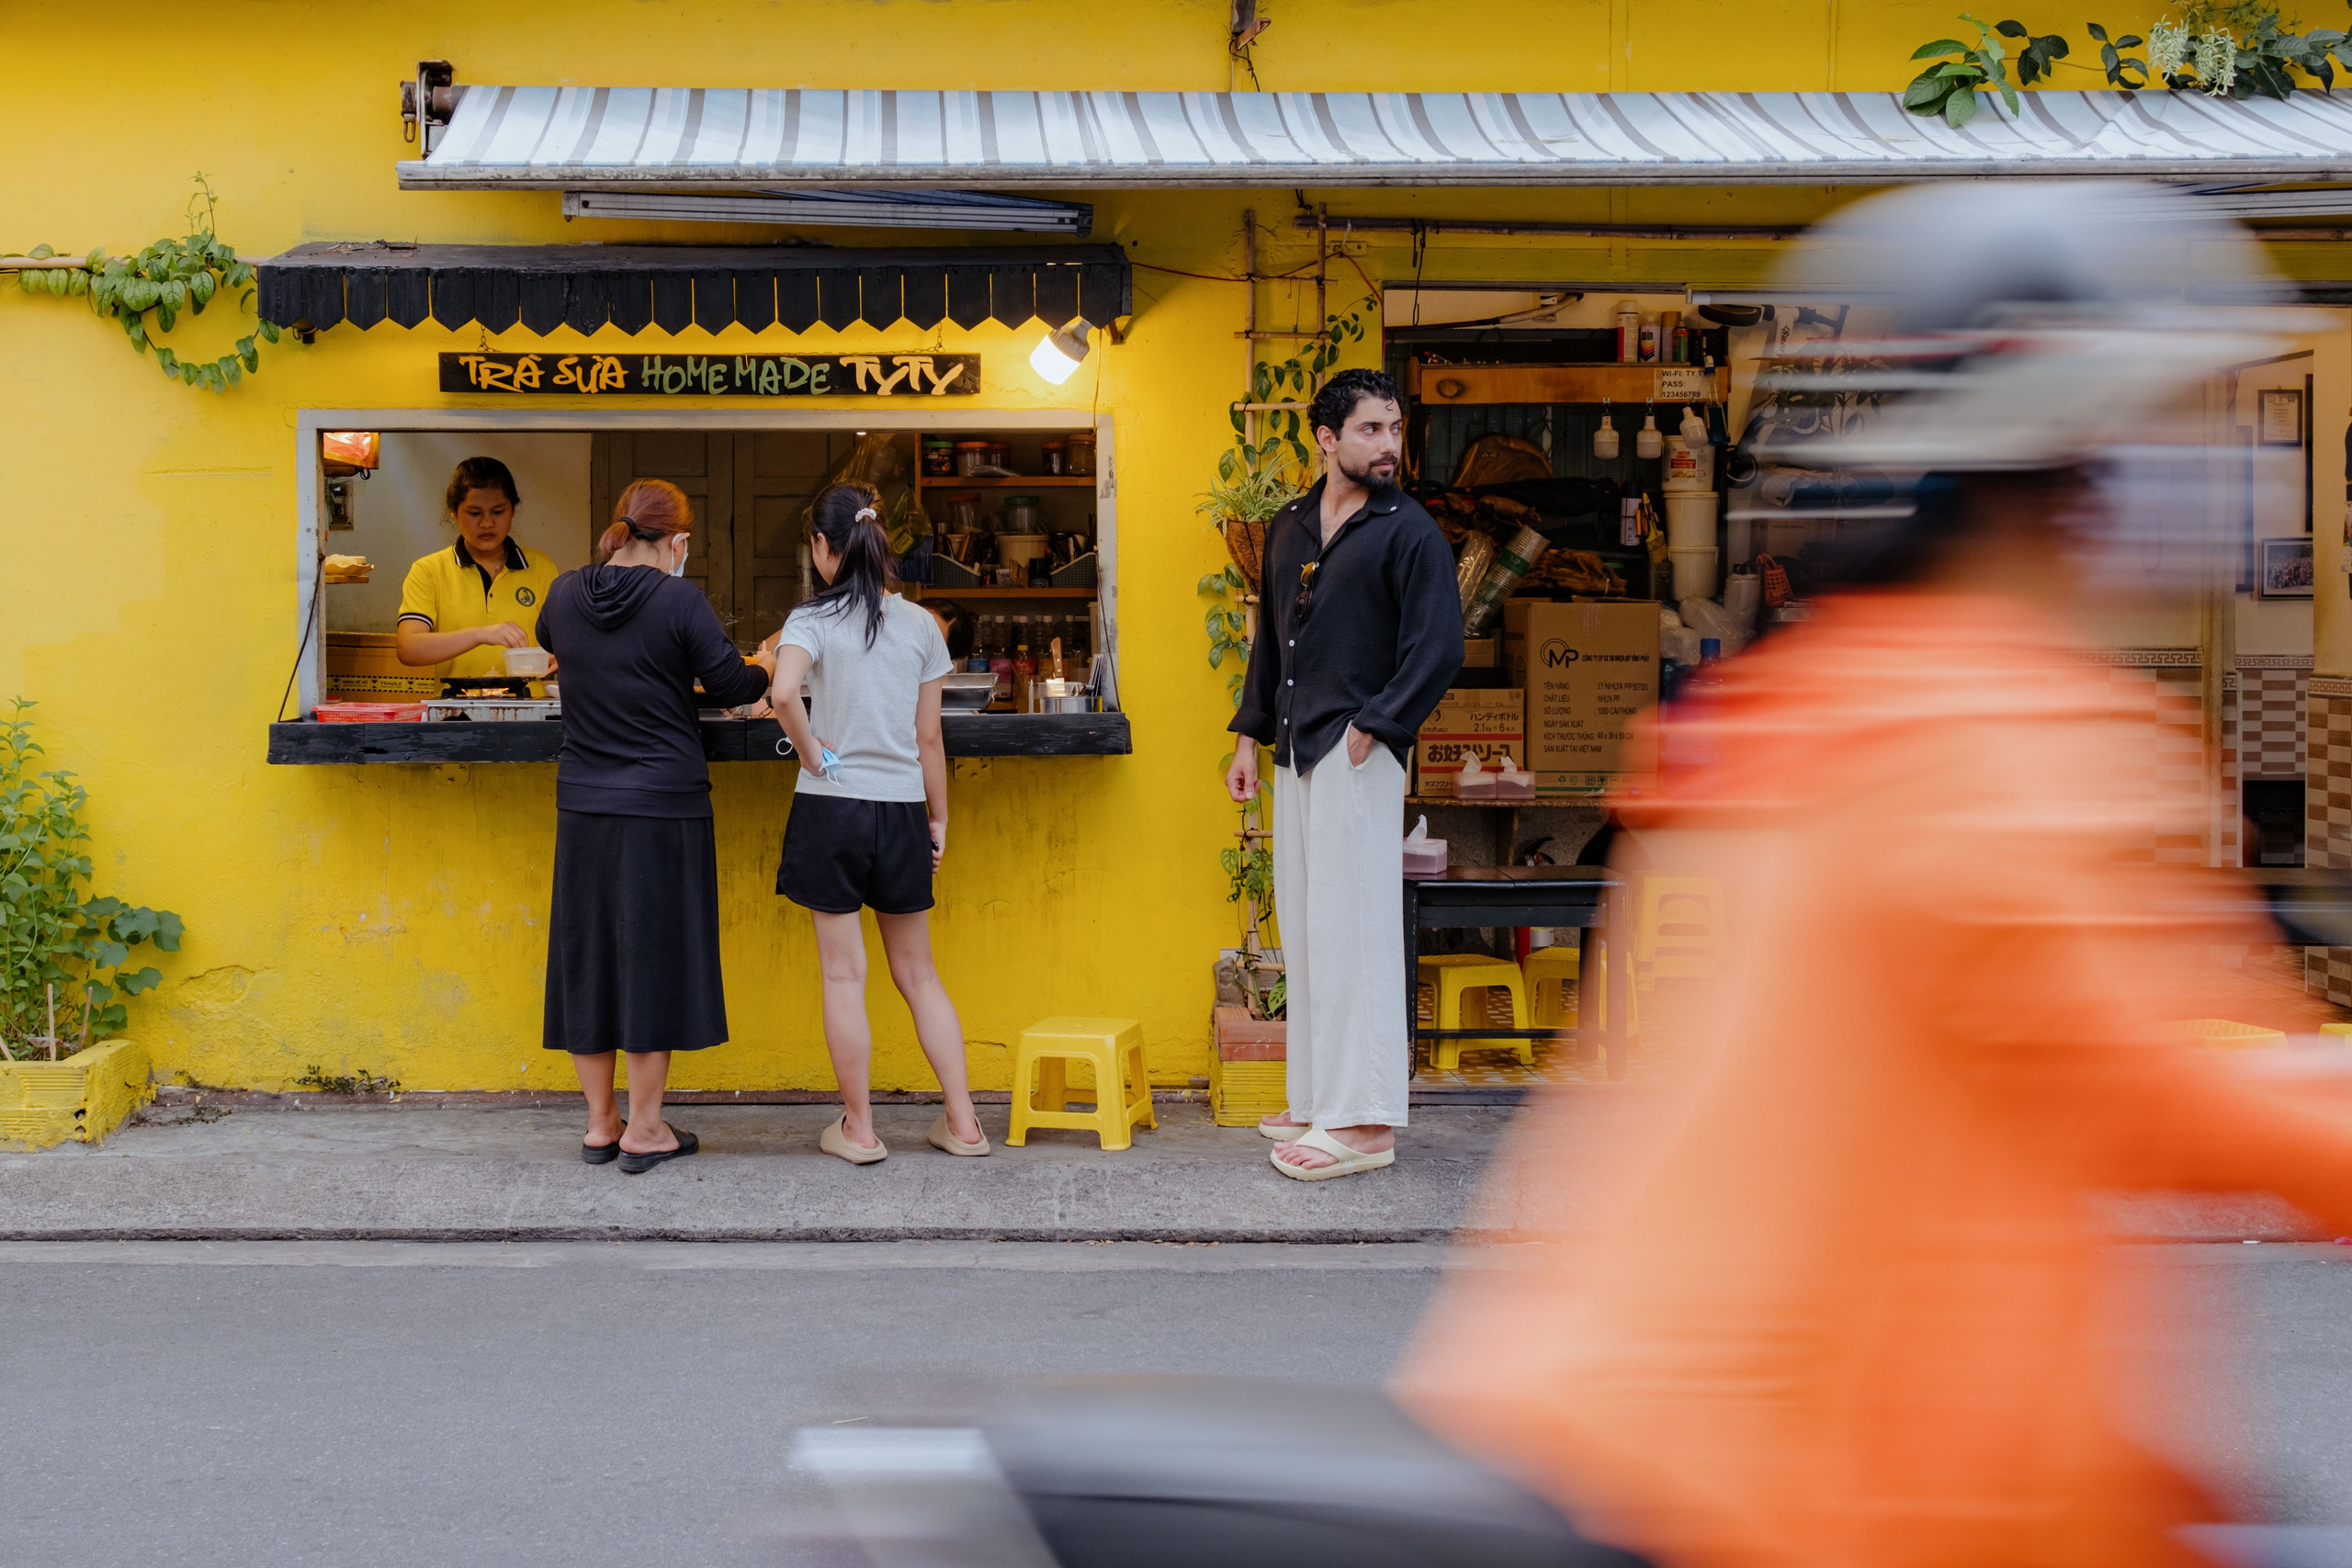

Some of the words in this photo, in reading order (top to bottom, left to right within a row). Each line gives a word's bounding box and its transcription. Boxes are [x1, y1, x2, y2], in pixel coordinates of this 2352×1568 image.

[458, 355, 545, 393] TRÀ
[1544, 681, 1554, 690] TÊN
[1555, 681, 1570, 690] HÀNG
[1604, 682, 1623, 691] NHỰA
[1598, 694, 1612, 704] NHỰA
[1613, 694, 1621, 703] PP
[1544, 705, 1552, 715] SỐ
[1590, 744, 1602, 752] NAM
